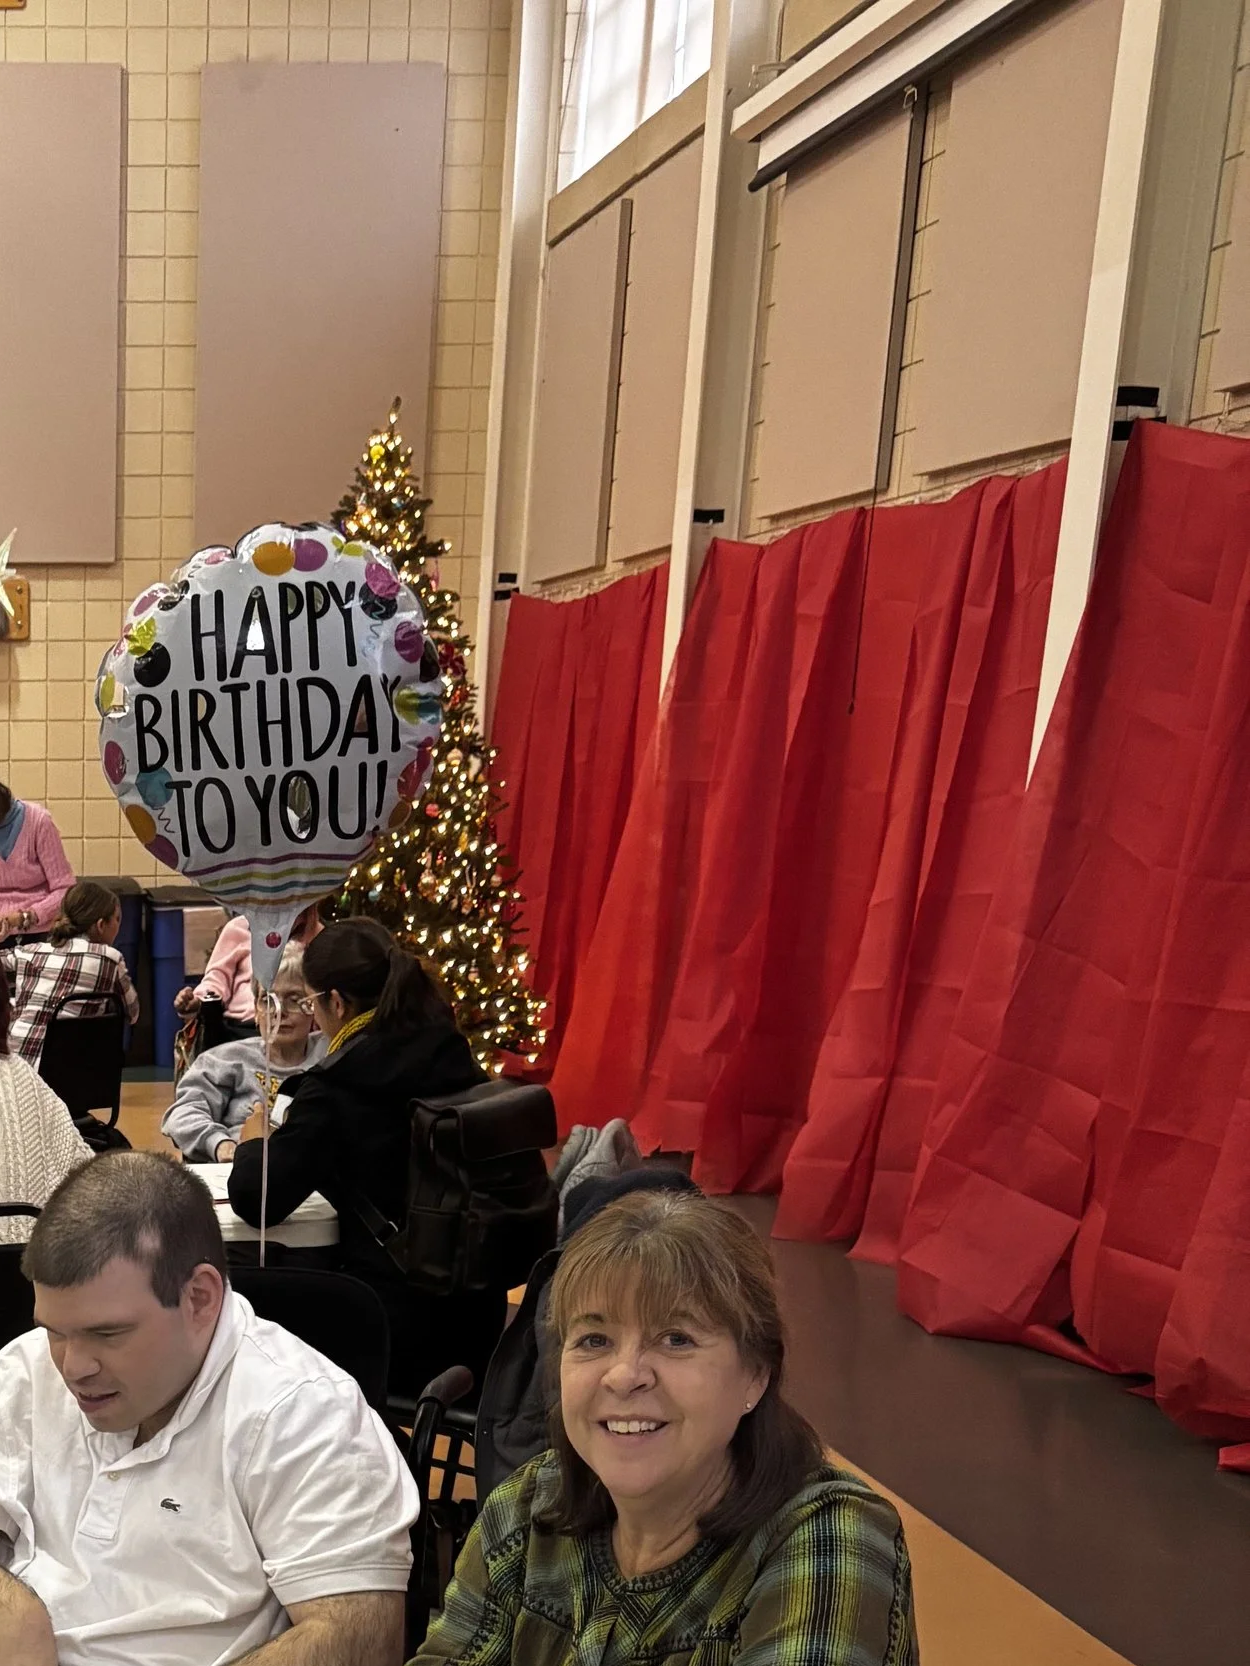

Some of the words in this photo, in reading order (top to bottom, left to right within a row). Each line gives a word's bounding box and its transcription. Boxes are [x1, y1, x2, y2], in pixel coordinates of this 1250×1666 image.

[190, 580, 357, 682] HAPPY
[134, 674, 402, 773] BIRTHDAY
[165, 776, 237, 857] TO
[244, 760, 388, 847] YOU!
